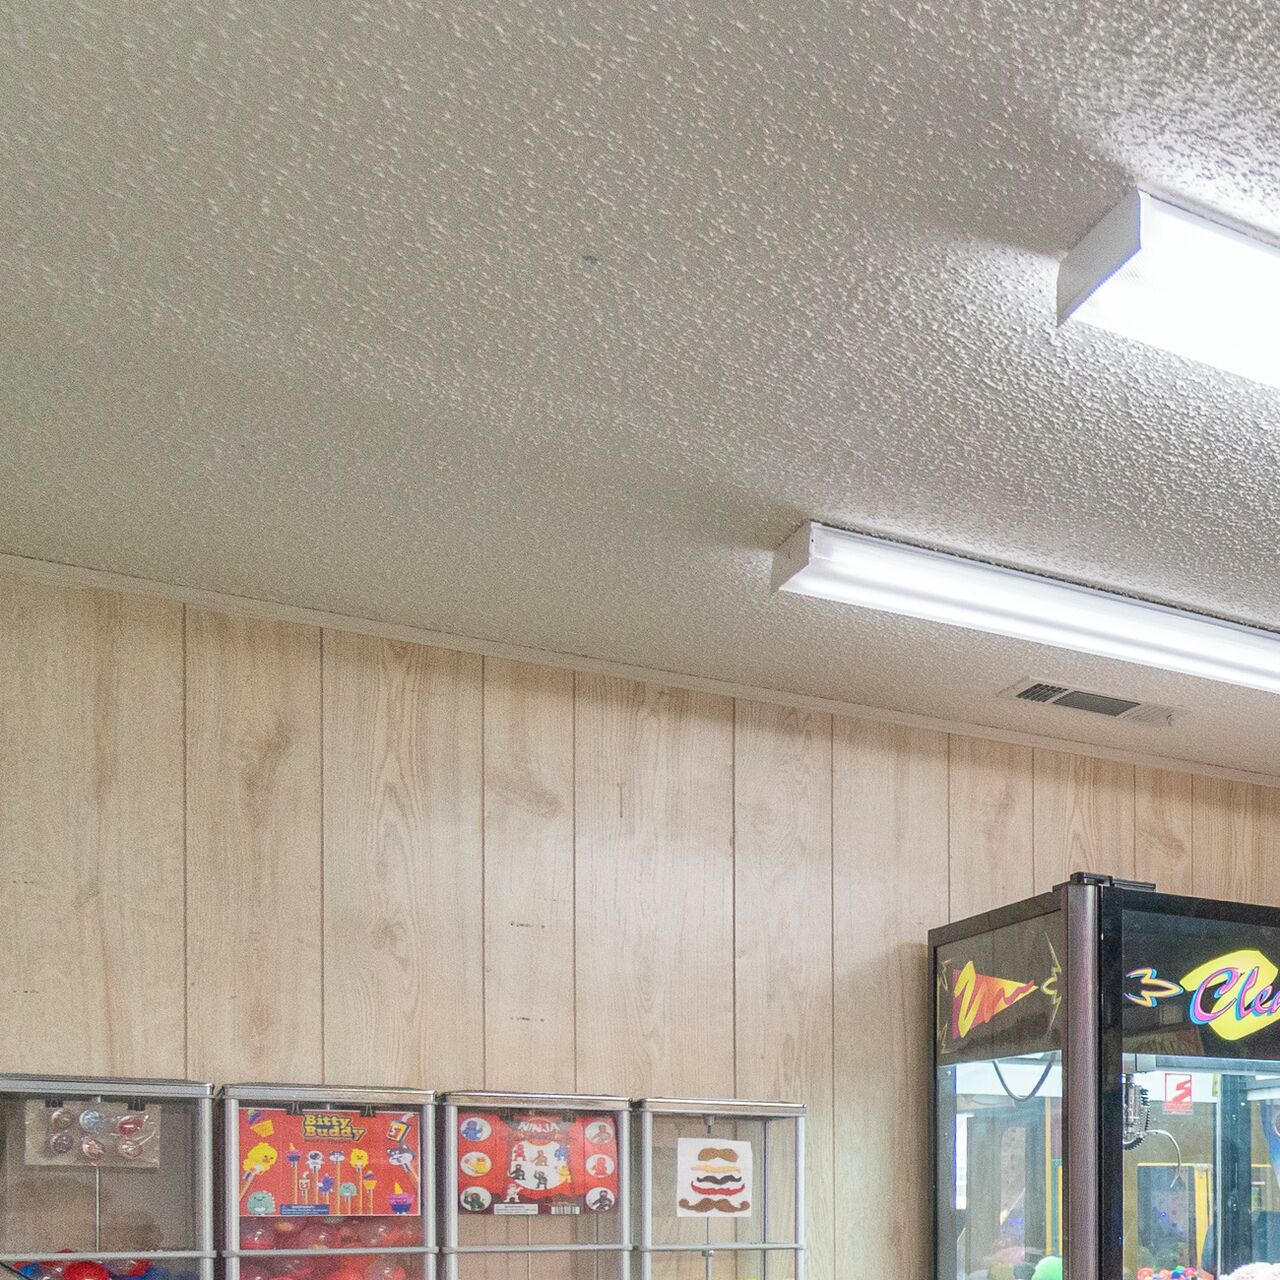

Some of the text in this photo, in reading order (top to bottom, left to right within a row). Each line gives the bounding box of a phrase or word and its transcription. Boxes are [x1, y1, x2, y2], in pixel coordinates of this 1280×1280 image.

[304, 1114, 352, 1128] Bitty
[518, 1120, 560, 1133] NINJA
[304, 1125, 366, 1141] Buddy
